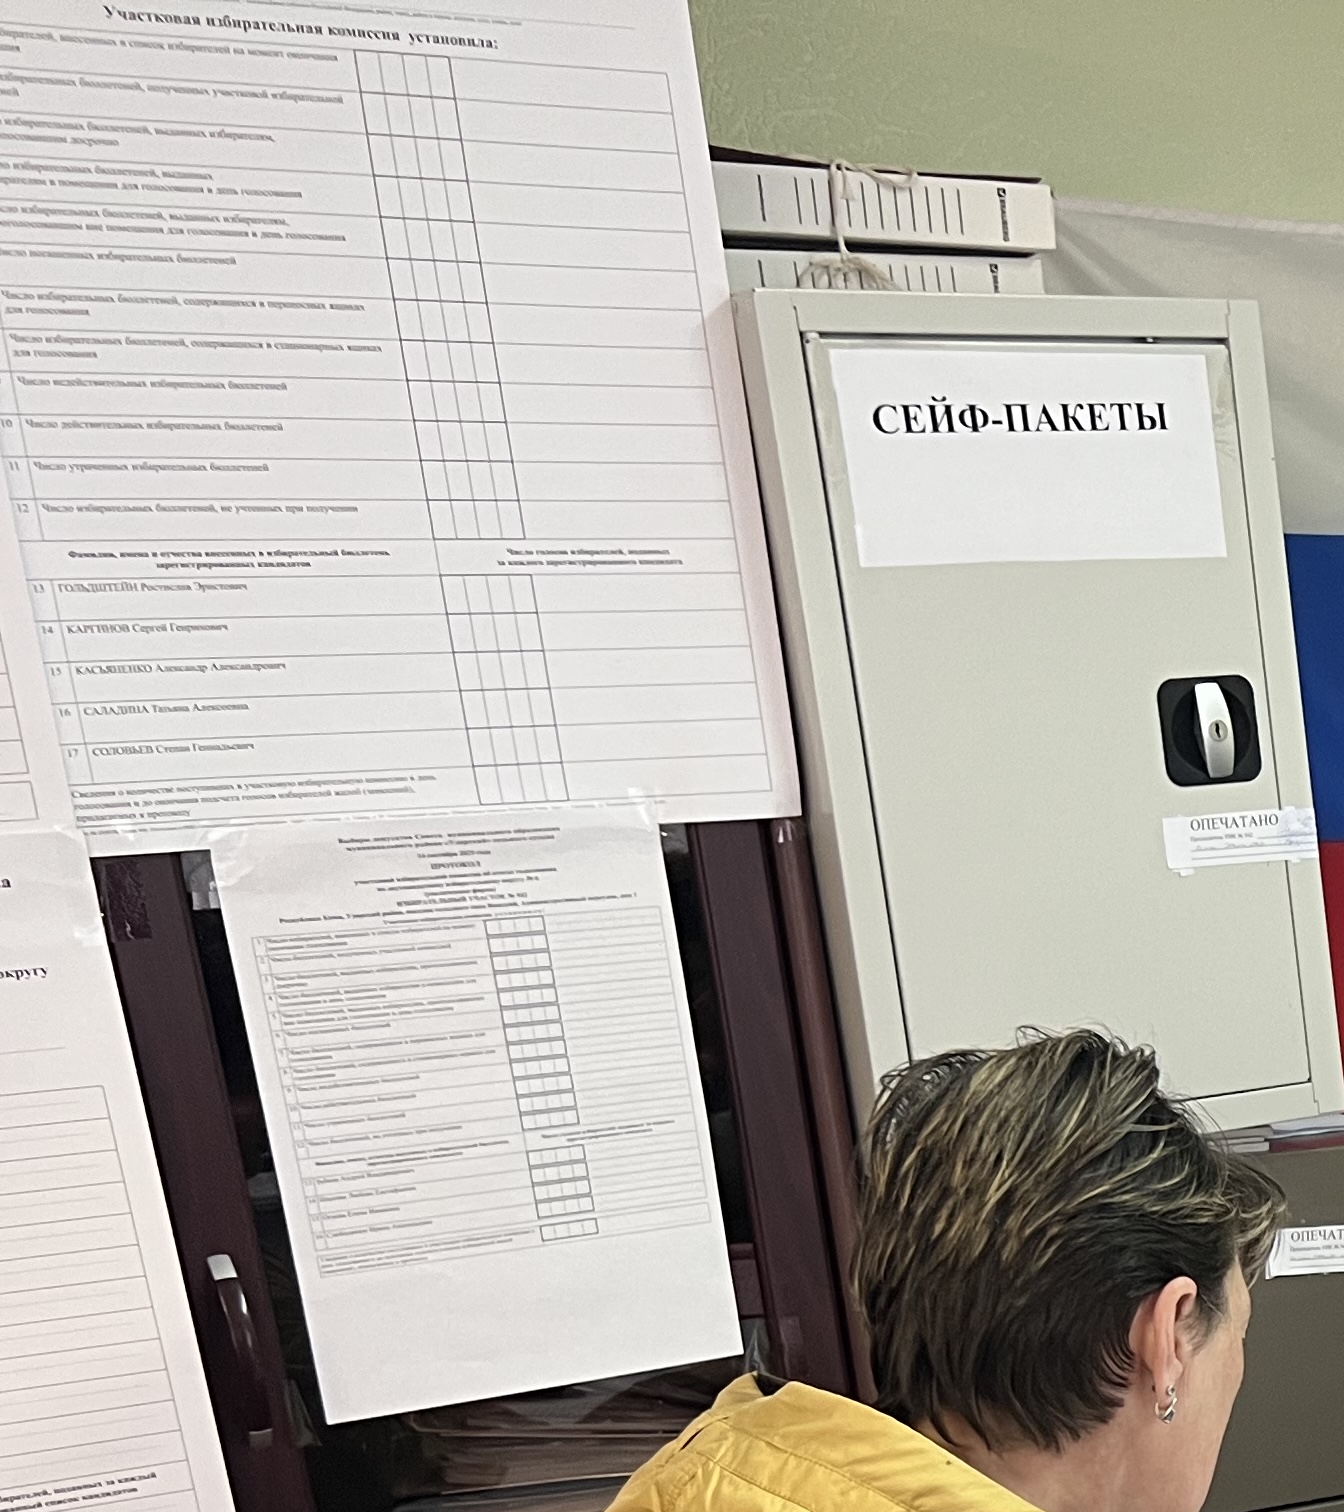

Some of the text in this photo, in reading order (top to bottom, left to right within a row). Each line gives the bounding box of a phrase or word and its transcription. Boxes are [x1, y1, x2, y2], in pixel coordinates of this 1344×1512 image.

[103, 5, 499, 51] Участковая избирательная комиссия установила:
[872, 396, 1169, 434] СЕЙФ-ПАКЕТЫ
[1190, 813, 1279, 832] ОПЕЧАТАНО
